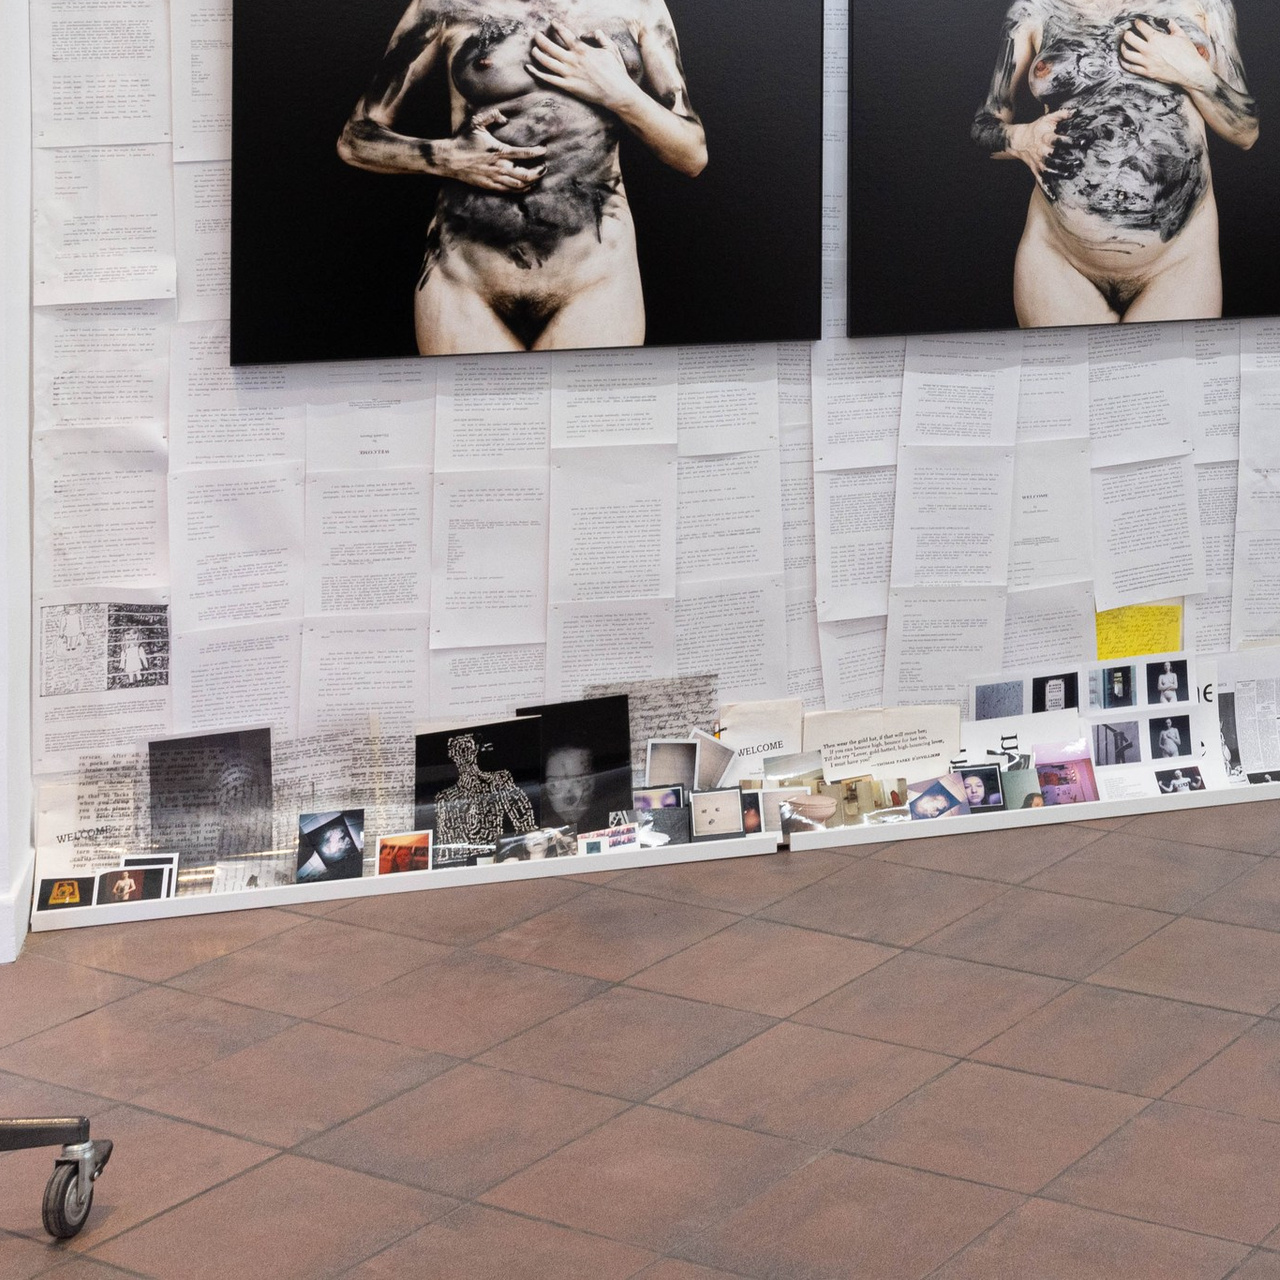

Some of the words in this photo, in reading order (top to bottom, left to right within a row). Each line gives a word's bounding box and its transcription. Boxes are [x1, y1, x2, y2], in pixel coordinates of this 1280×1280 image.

[857, 736, 869, 745] gold
[884, 738, 901, 746] bounce
[737, 740, 785, 758] WELCOME
[111, 752, 127, 760] After
[89, 760, 109, 768] pocket
[157, 824, 171, 832] hope
[56, 824, 113, 845] WELCOME
[203, 835, 217, 843] hope
[72, 862, 88, 870] your
